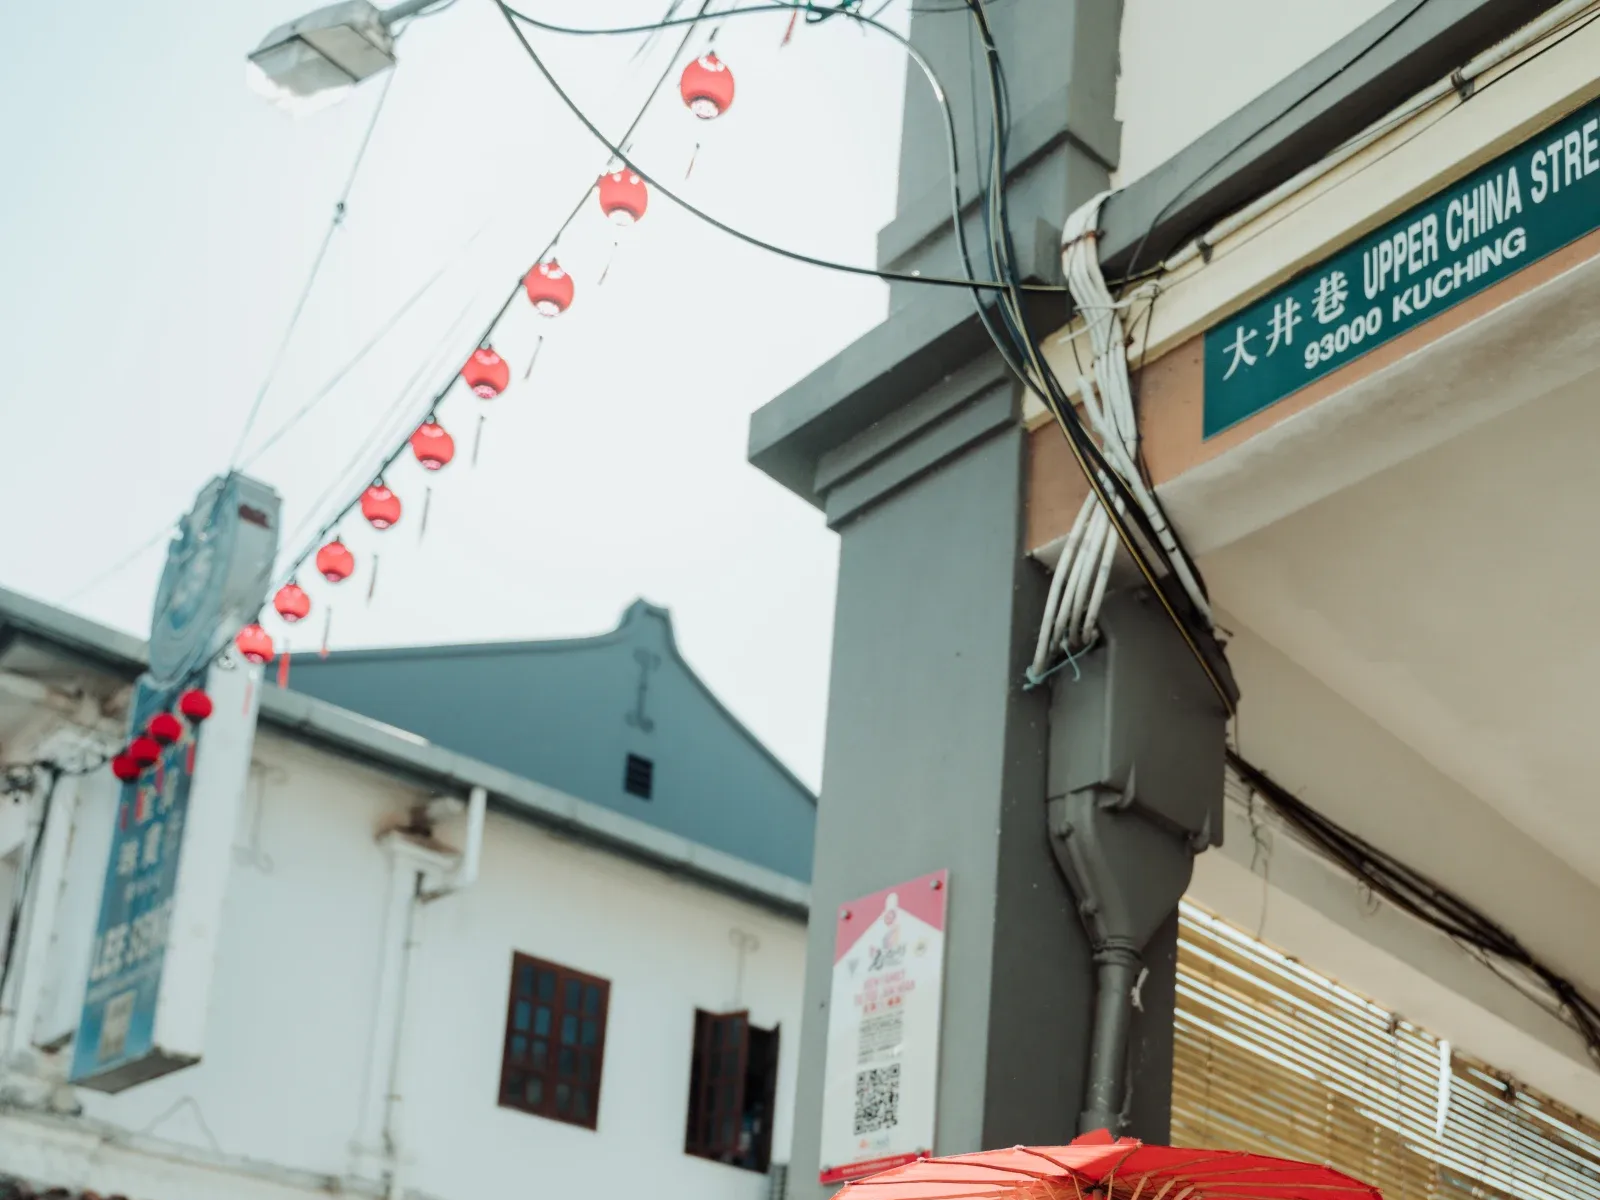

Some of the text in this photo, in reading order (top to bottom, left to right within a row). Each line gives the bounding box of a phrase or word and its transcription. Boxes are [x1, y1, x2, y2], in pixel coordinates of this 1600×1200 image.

[1363, 118, 1600, 300] UPPER CHINA STRE
[1222, 271, 1348, 381] 大井巷
[1304, 227, 1526, 370] 93000 KUCHING
